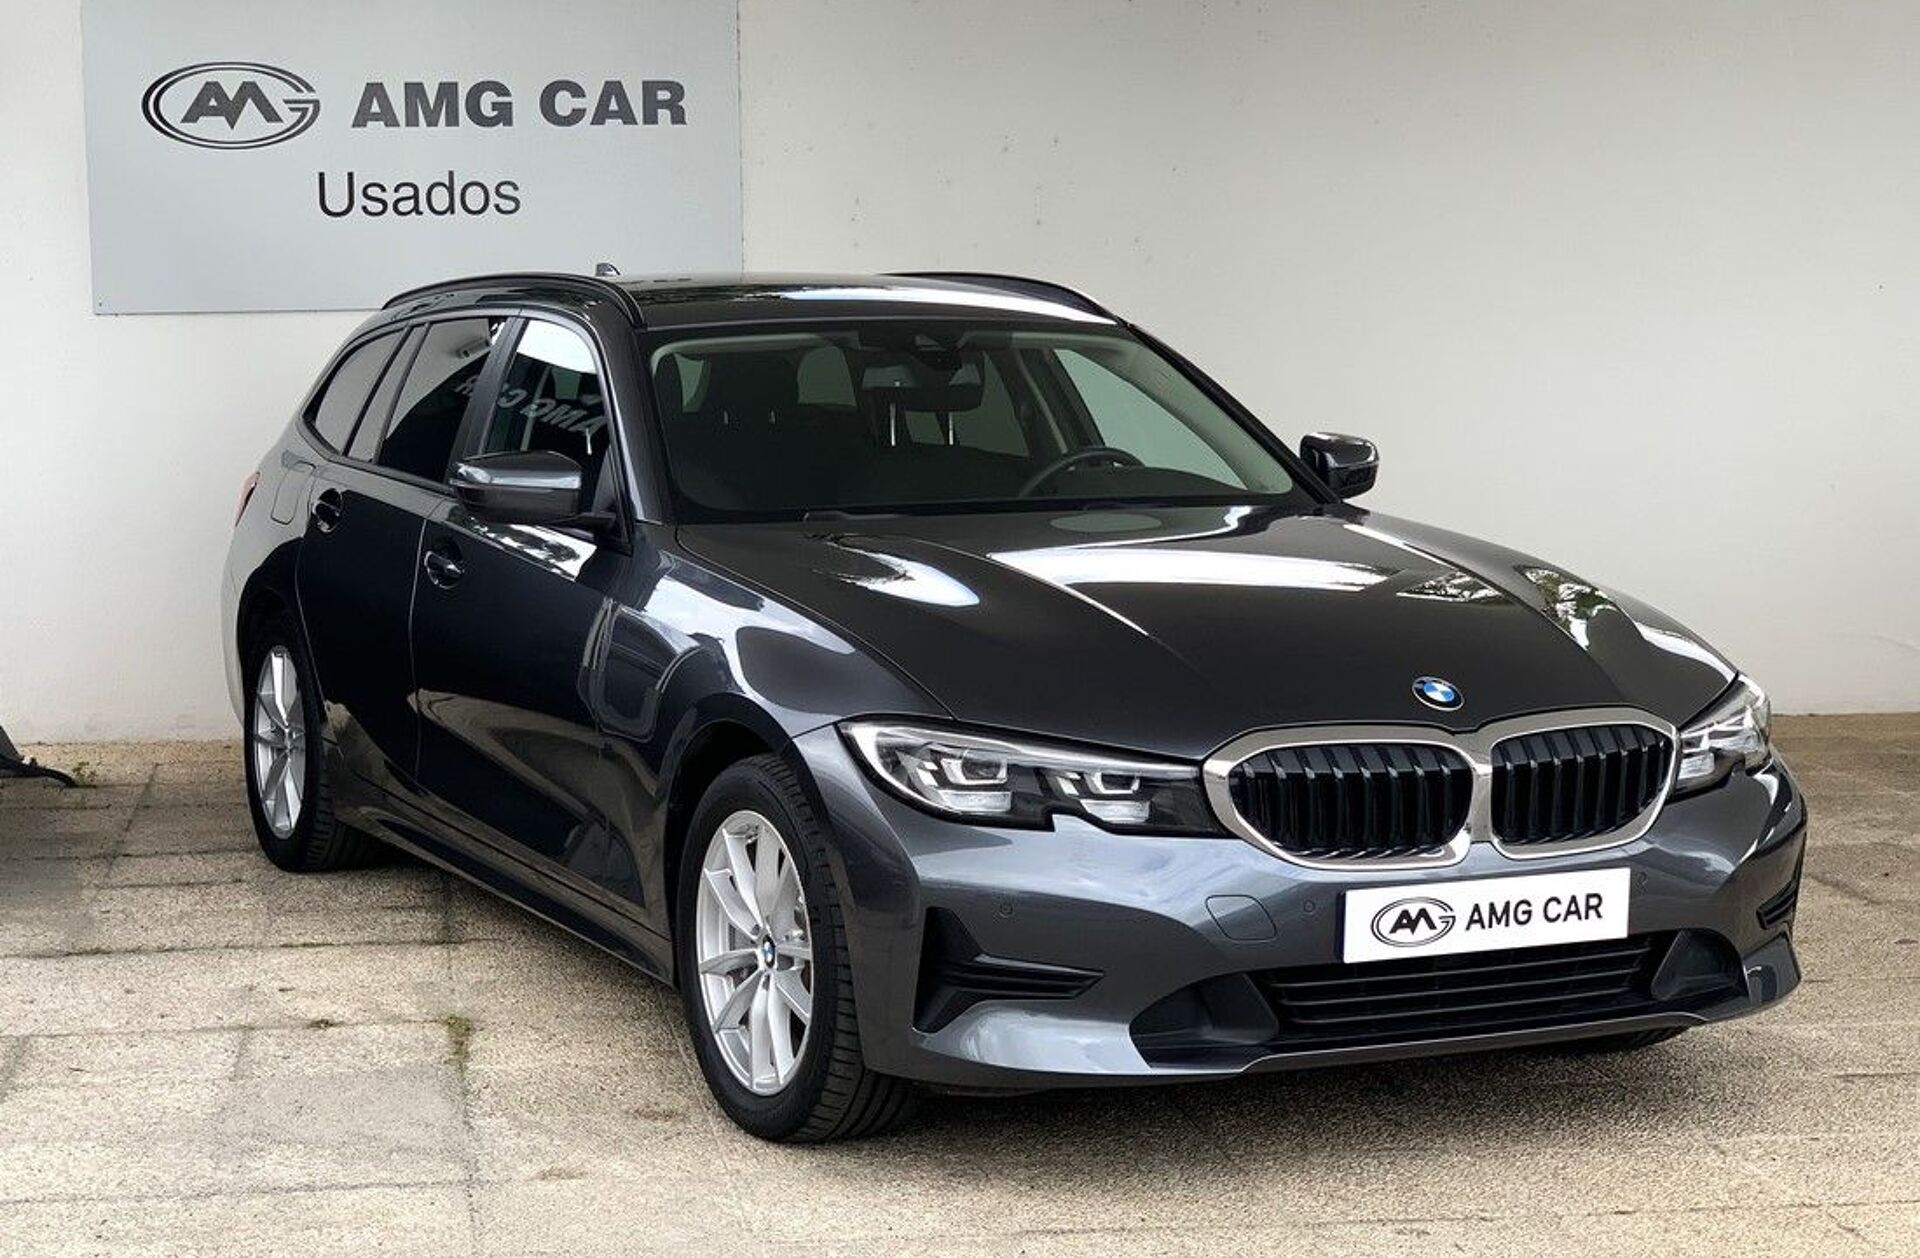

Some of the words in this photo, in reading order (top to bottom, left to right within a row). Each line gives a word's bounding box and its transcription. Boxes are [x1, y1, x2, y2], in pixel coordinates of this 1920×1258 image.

[351, 81, 514, 128] AMG
[539, 80, 687, 127] CAR
[318, 170, 521, 218] Usados
[1465, 900, 1533, 931] AMG
[1542, 893, 1603, 923] CAR
